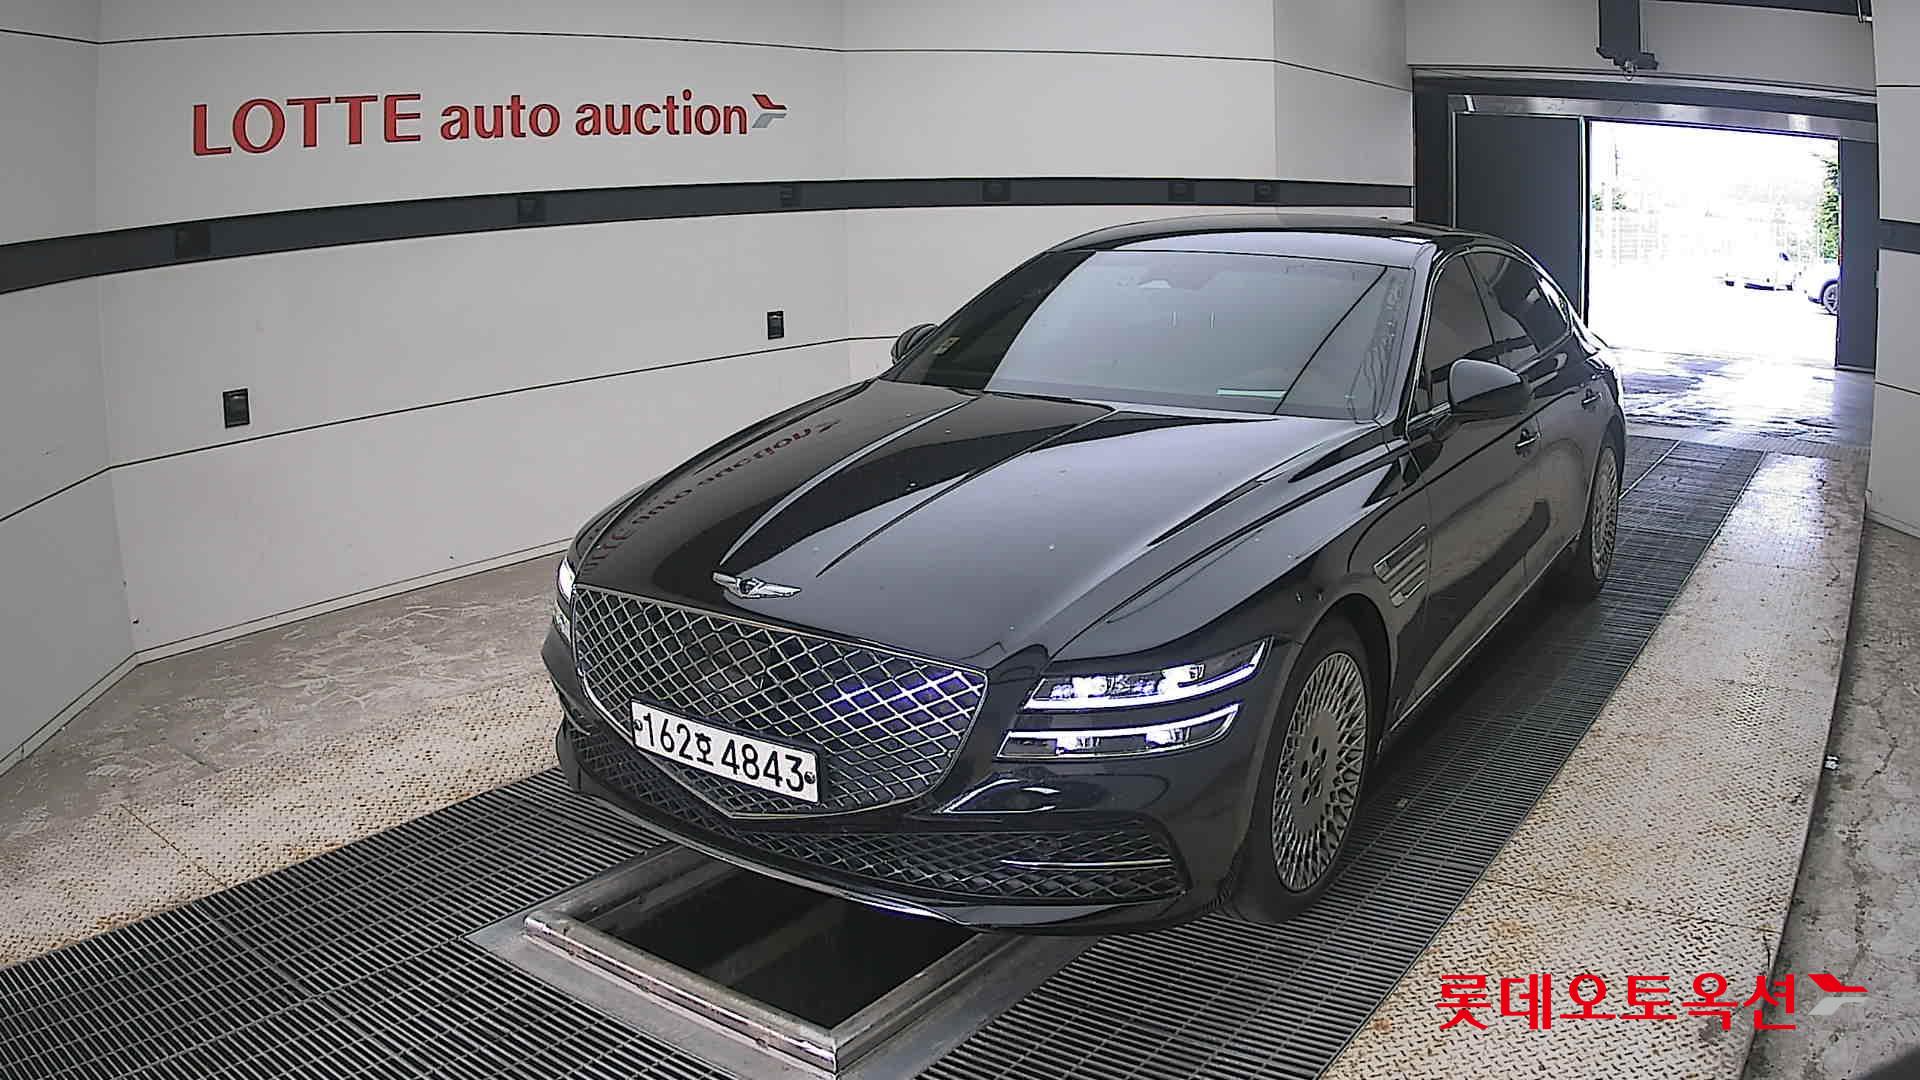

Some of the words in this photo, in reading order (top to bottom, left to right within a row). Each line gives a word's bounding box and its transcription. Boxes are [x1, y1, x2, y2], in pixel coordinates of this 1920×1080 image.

[192, 94, 422, 157] LOTTE
[440, 96, 560, 140] auto
[575, 89, 748, 137] auction
[721, 739, 804, 792] 4843
